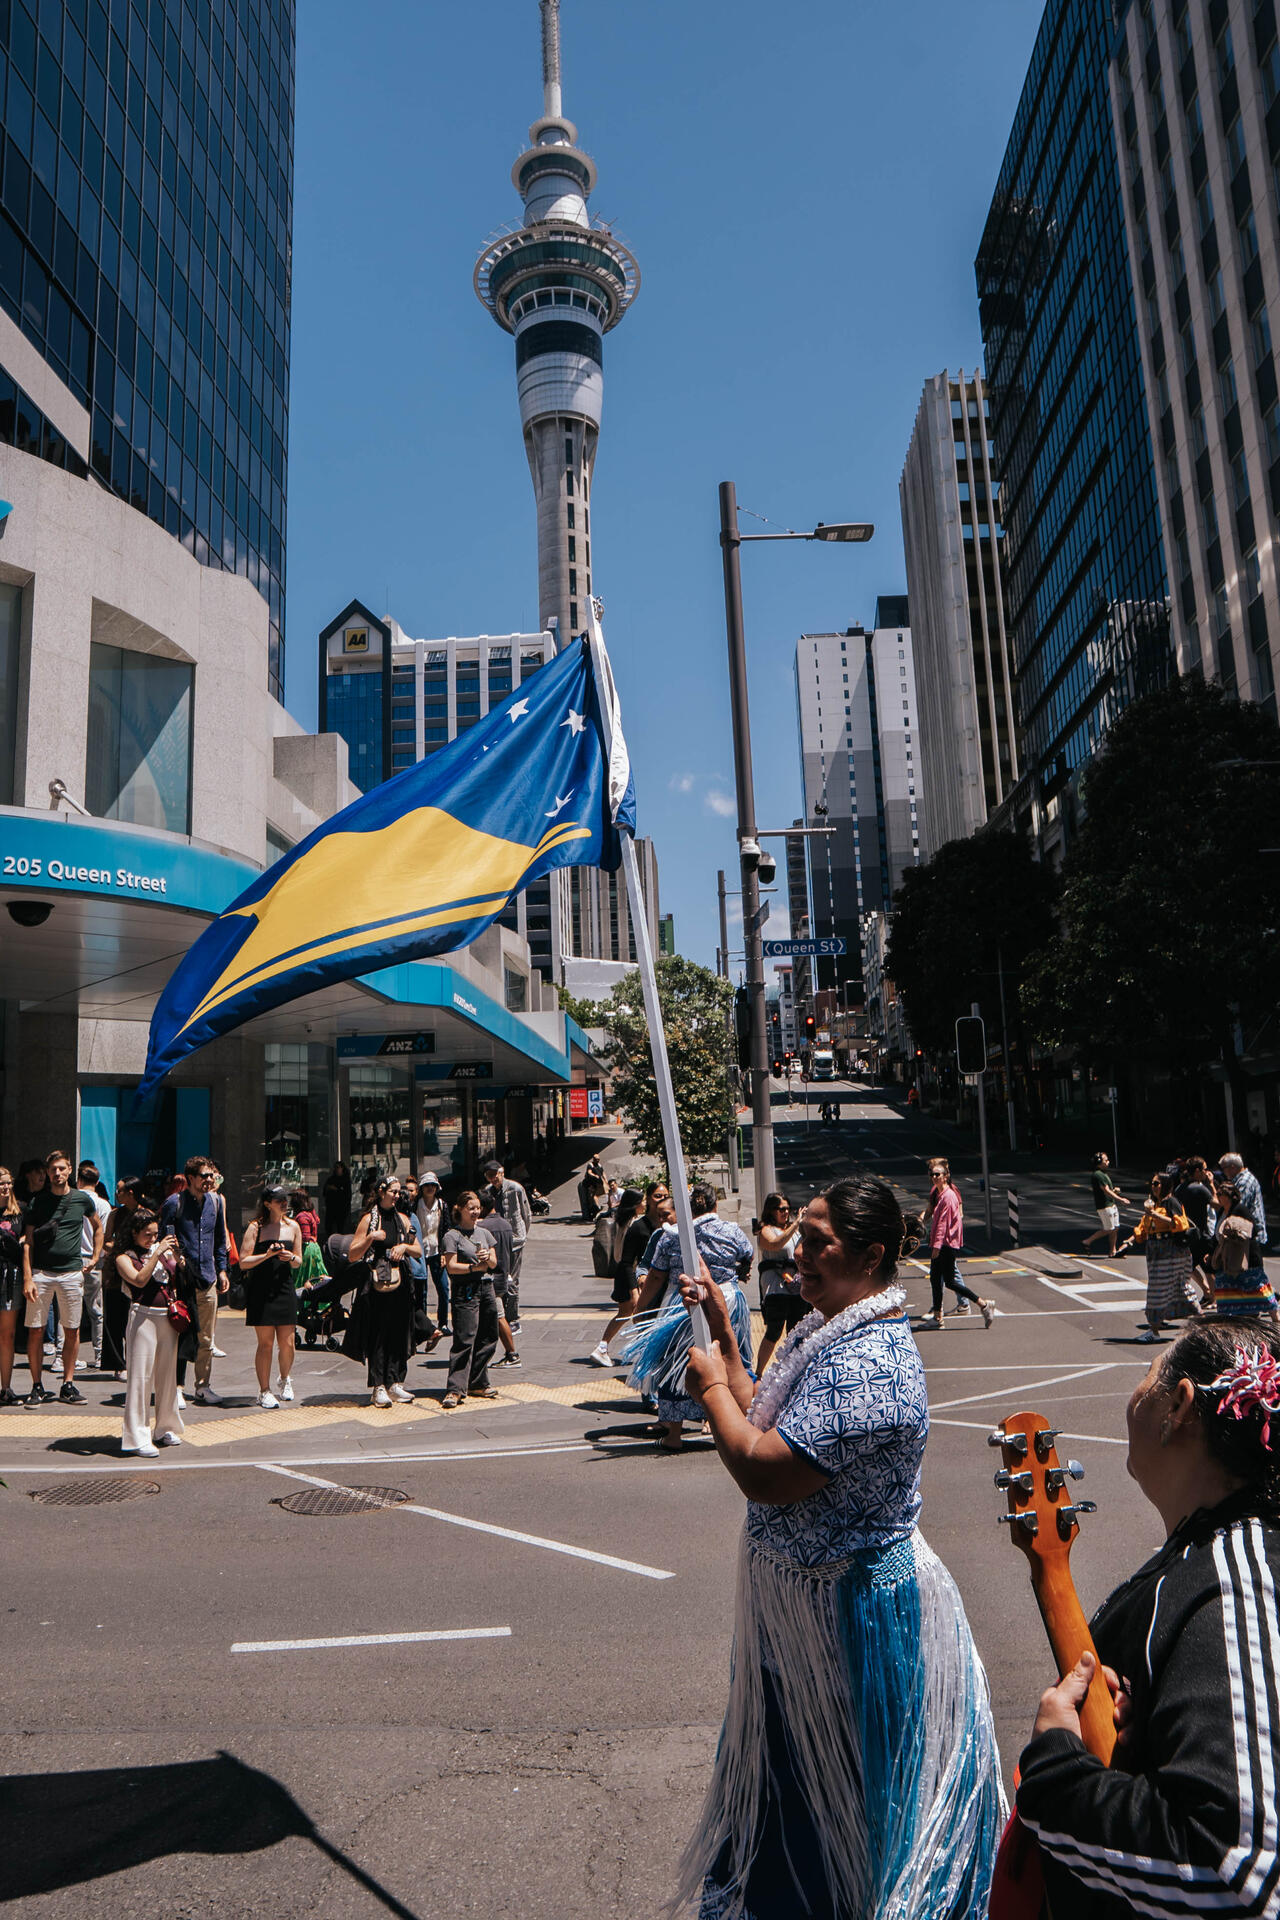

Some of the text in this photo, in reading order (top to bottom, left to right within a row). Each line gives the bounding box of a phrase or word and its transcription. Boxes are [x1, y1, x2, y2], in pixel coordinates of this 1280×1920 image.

[348, 633, 367, 646] AA
[3, 856, 167, 893] 205 Queen Street
[773, 941, 835, 955] Queen St
[386, 1040, 413, 1051] ANZ
[454, 1068, 476, 1077] ANZ
